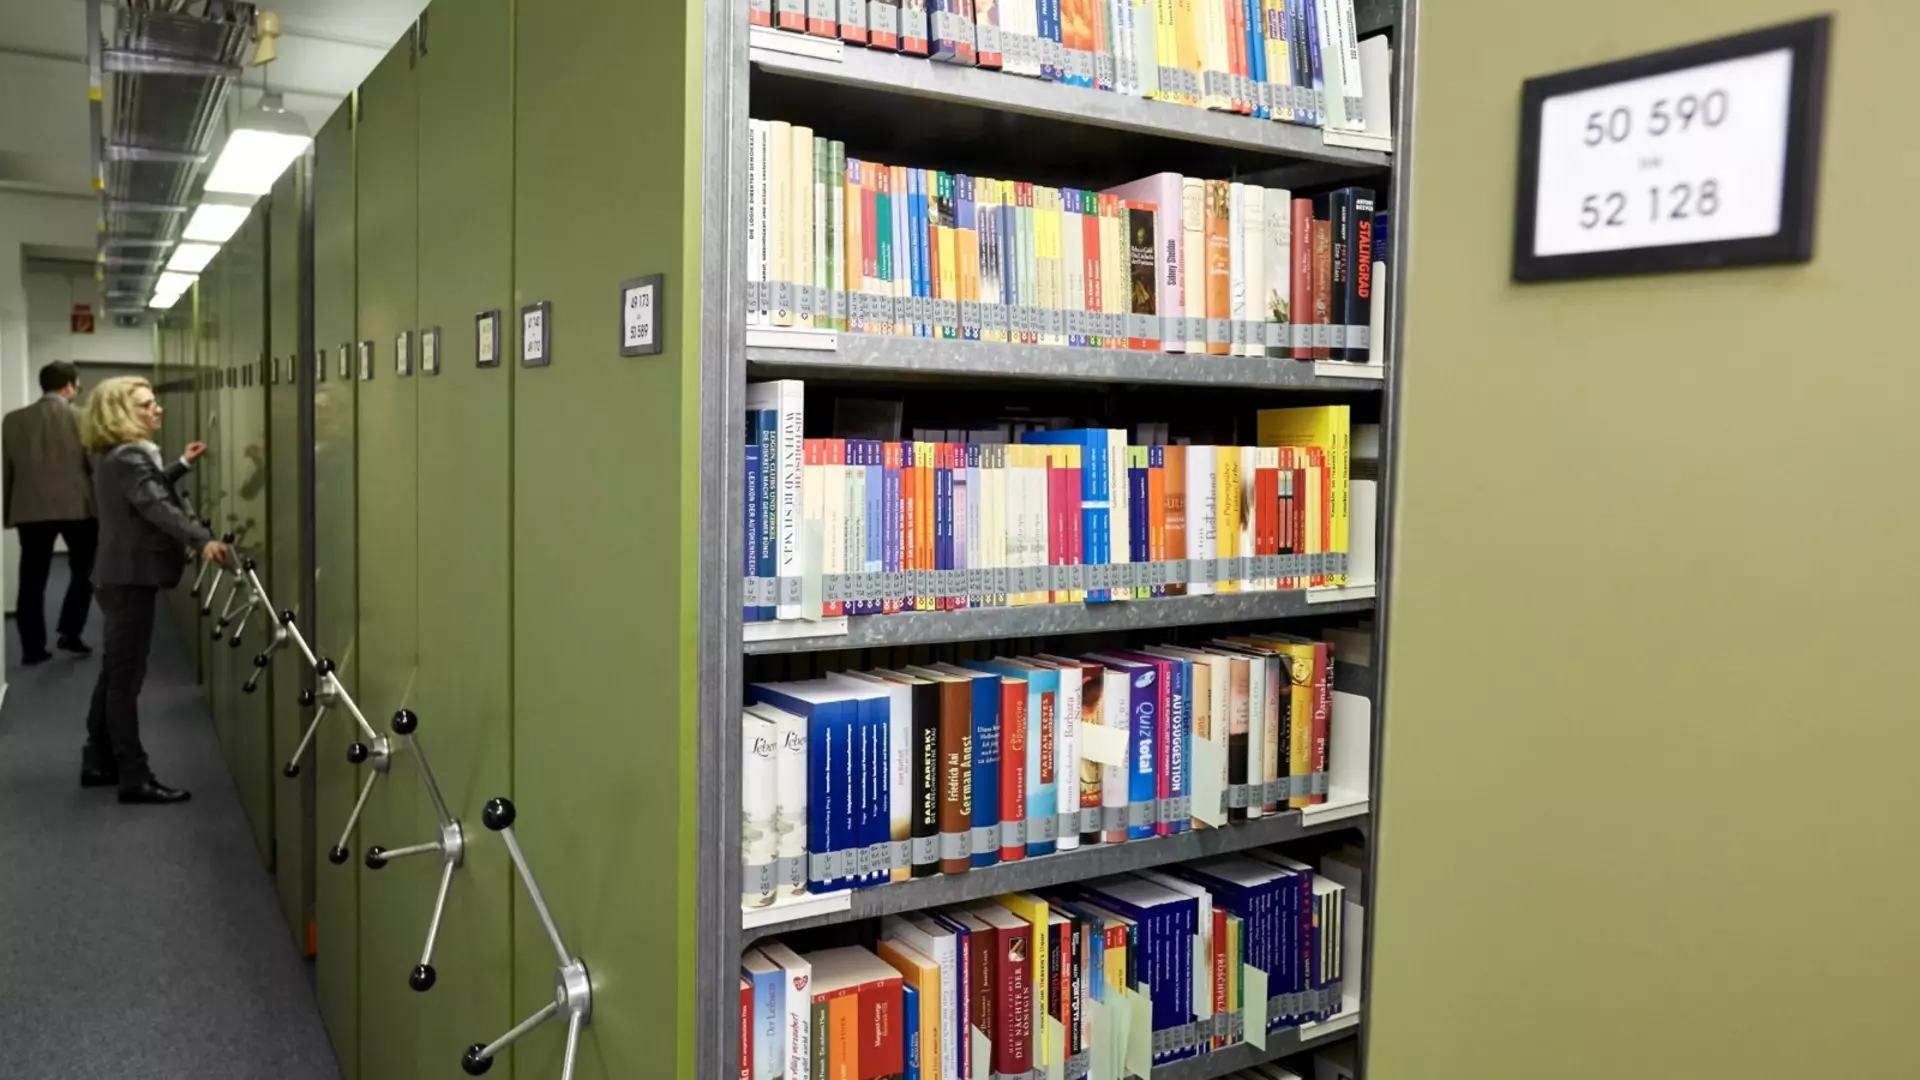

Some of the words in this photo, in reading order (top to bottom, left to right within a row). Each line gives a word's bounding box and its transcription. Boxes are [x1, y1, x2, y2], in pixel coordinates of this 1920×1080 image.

[1584, 106, 1632, 147] 50
[1647, 89, 1730, 137] 590
[1579, 191, 1627, 230] 52
[1649, 179, 1720, 223] 128
[1166, 239, 1177, 264] Sheldon
[1358, 220, 1372, 298] STALINGRAD
[1166, 265, 1177, 286] Sidney
[784, 412, 794, 461] WAFFEN
[784, 463, 794, 489] UND
[784, 492, 794, 565] RÜSTUNGEN
[1063, 697, 1074, 738] Barbara
[1315, 678, 1326, 720] Damals
[1012, 700, 1023, 751] Cappuccino
[1172, 694, 1182, 791] AUTOSUGGESTION
[948, 753, 959, 765] Ani
[960, 735, 972, 768] Angst
[948, 767, 959, 802] Friedrich
[960, 770, 972, 816] German
[1014, 967, 1023, 990] DER
[1217, 953, 1225, 1013] FROSCHPELZ
[766, 1022, 776, 1037] Der
[790, 1012, 800, 1054] verzaubert
[1014, 992, 1023, 1037] NÄCHTE
[1014, 1040, 1023, 1060] DIE
